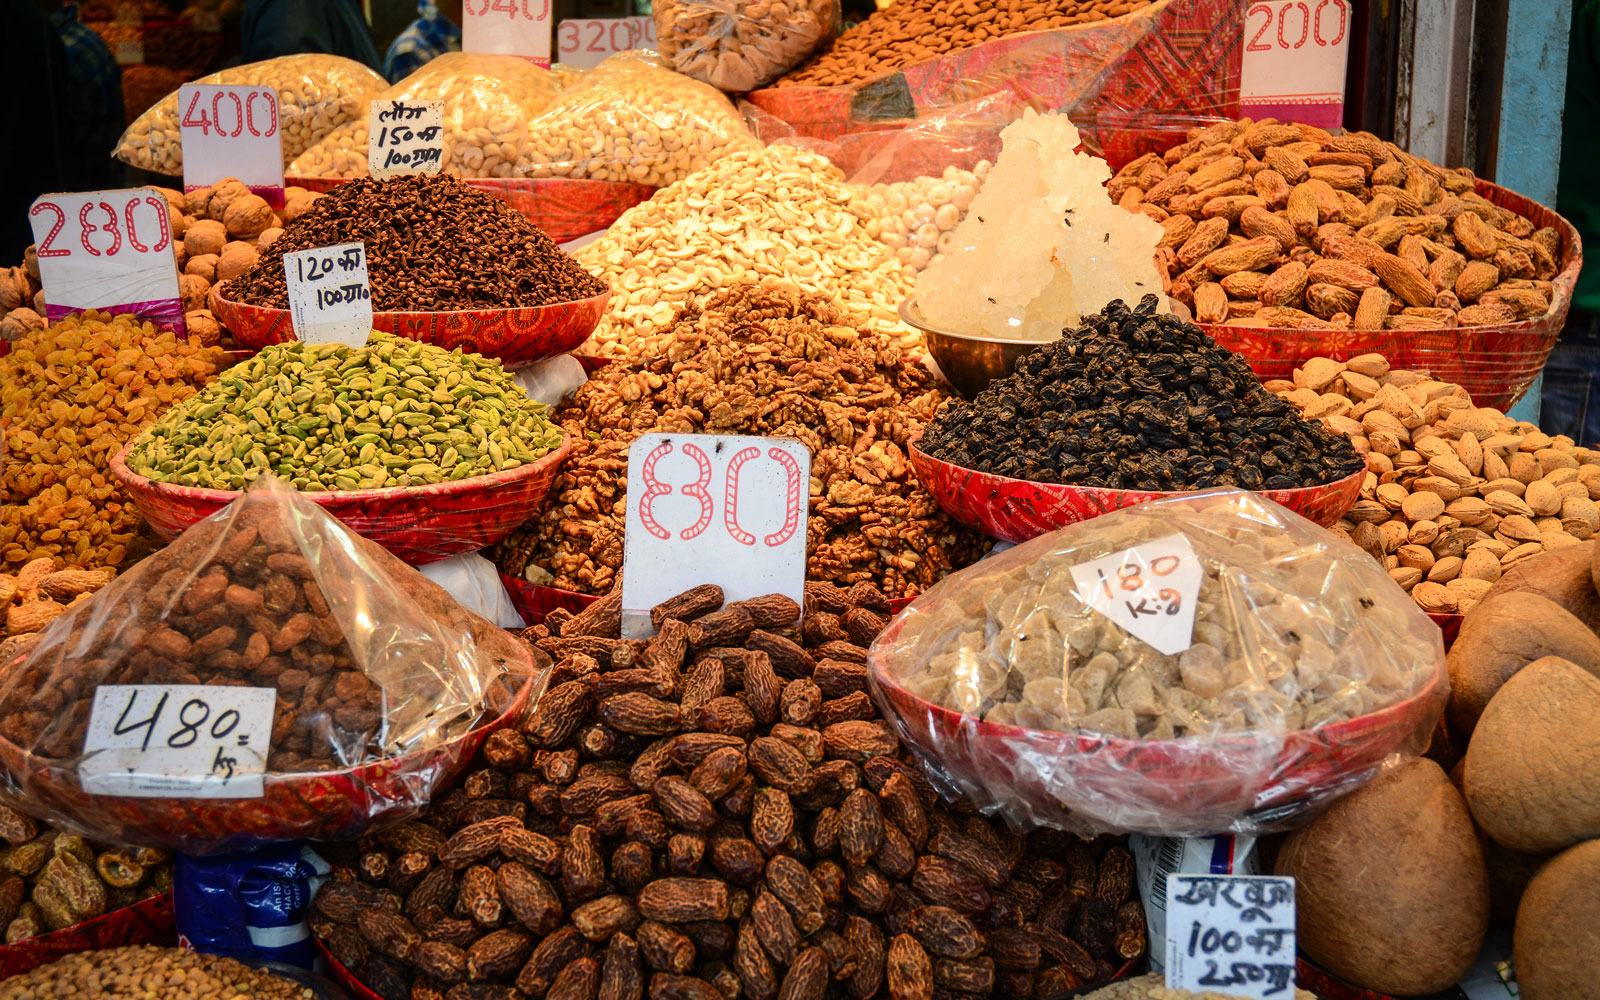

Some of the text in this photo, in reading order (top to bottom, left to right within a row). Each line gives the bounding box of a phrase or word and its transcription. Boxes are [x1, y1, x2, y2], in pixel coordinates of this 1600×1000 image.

[559, 21, 633, 52] 320
[1246, 0, 1346, 52] 200
[182, 91, 277, 137] 400
[378, 127, 414, 148] 150
[31, 197, 169, 257] 280
[298, 256, 334, 283] 120
[639, 443, 800, 547] 80
[1097, 555, 1180, 599] 180
[273, 897, 283, 911] An
[1188, 920, 1242, 957] 100
